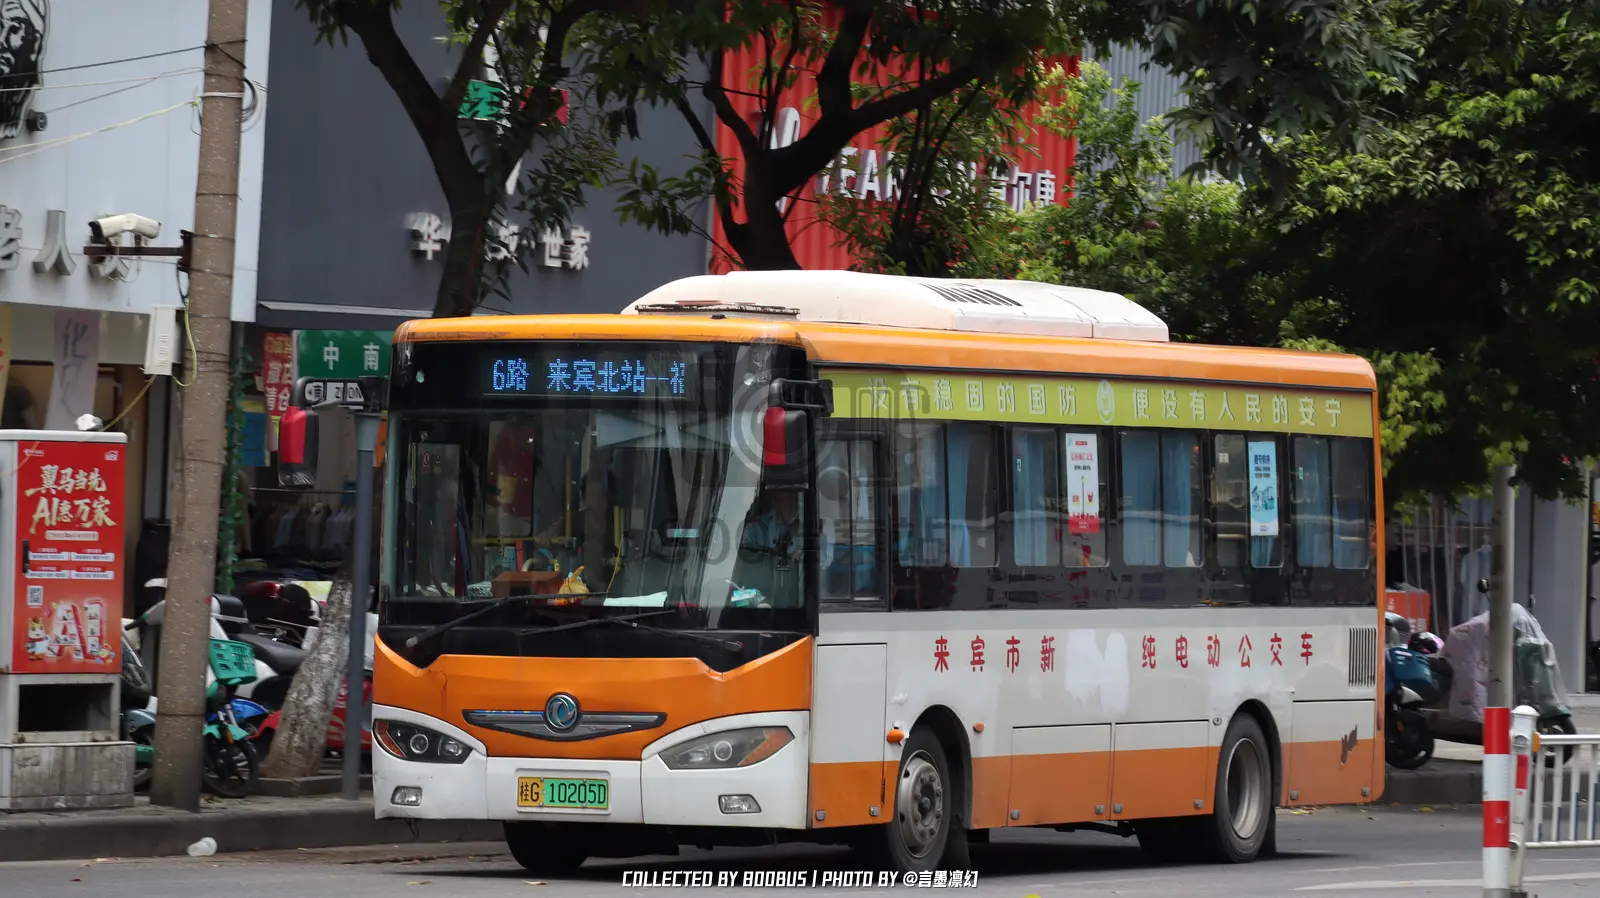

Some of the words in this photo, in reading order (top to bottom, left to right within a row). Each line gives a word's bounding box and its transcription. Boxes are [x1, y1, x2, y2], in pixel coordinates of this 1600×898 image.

[323, 341, 381, 371] 中南
[493, 358, 529, 391] 6路
[868, 376, 1077, 417] 没有稳固的国防
[1133, 387, 1342, 428] 便没有人民的安宁
[25, 464, 107, 497] 翼马当先
[29, 495, 118, 534] AI惠万家
[1141, 632, 1313, 670] 纯电动公交车
